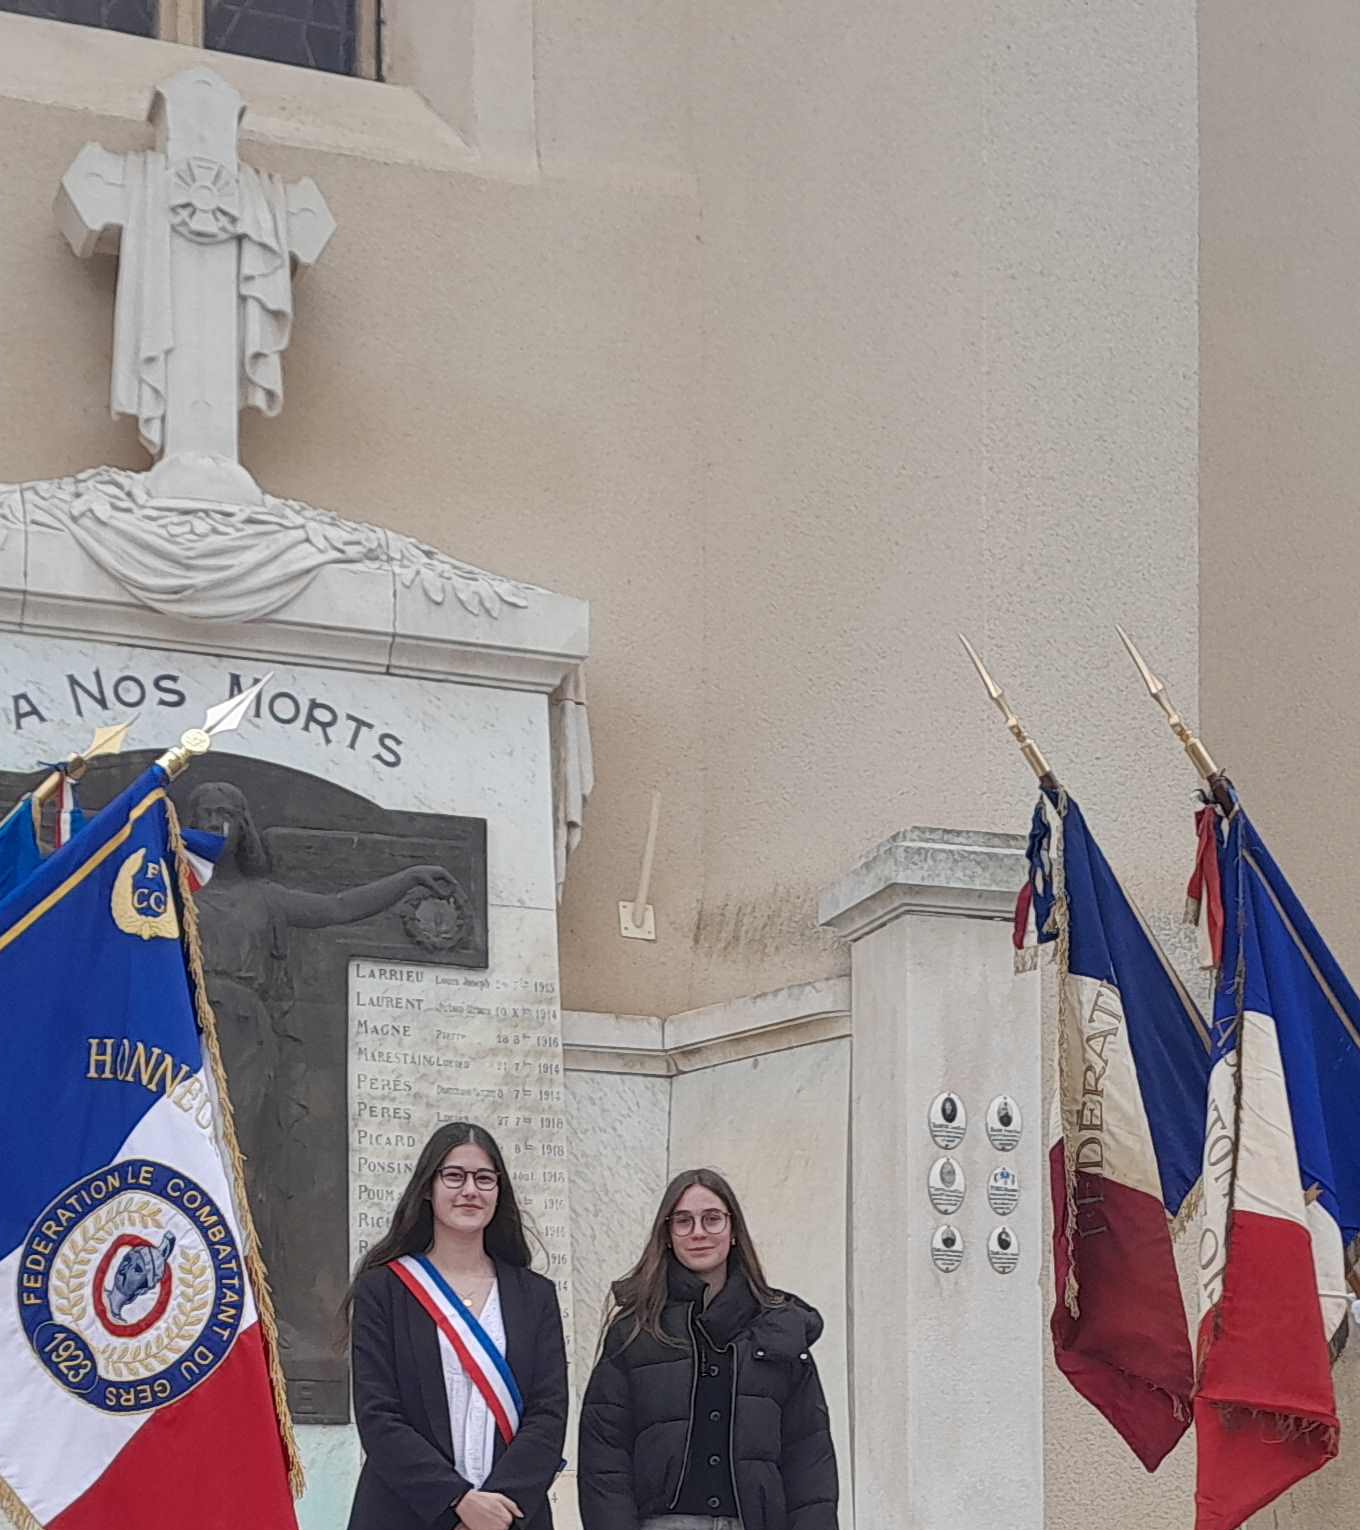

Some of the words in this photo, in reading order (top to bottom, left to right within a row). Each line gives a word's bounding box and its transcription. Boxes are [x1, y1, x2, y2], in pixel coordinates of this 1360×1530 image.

[12, 691, 48, 731] A
[66, 666, 187, 718] NOS
[227, 671, 404, 769] MORTS
[355, 963, 425, 984] LARRIEU
[356, 991, 425, 1011] LAURENT
[357, 1019, 412, 1038] MAGNE
[357, 1101, 413, 1121] PERES
[357, 1129, 416, 1148] PICARD
[127, 1165, 155, 1185] LE
[23, 1172, 121, 1306] FEDERATION
[166, 1178, 240, 1342] COMBATTANT
[43, 1332, 92, 1383] 1923
[181, 1345, 214, 1381] DU
[105, 1379, 171, 1407] GERS
